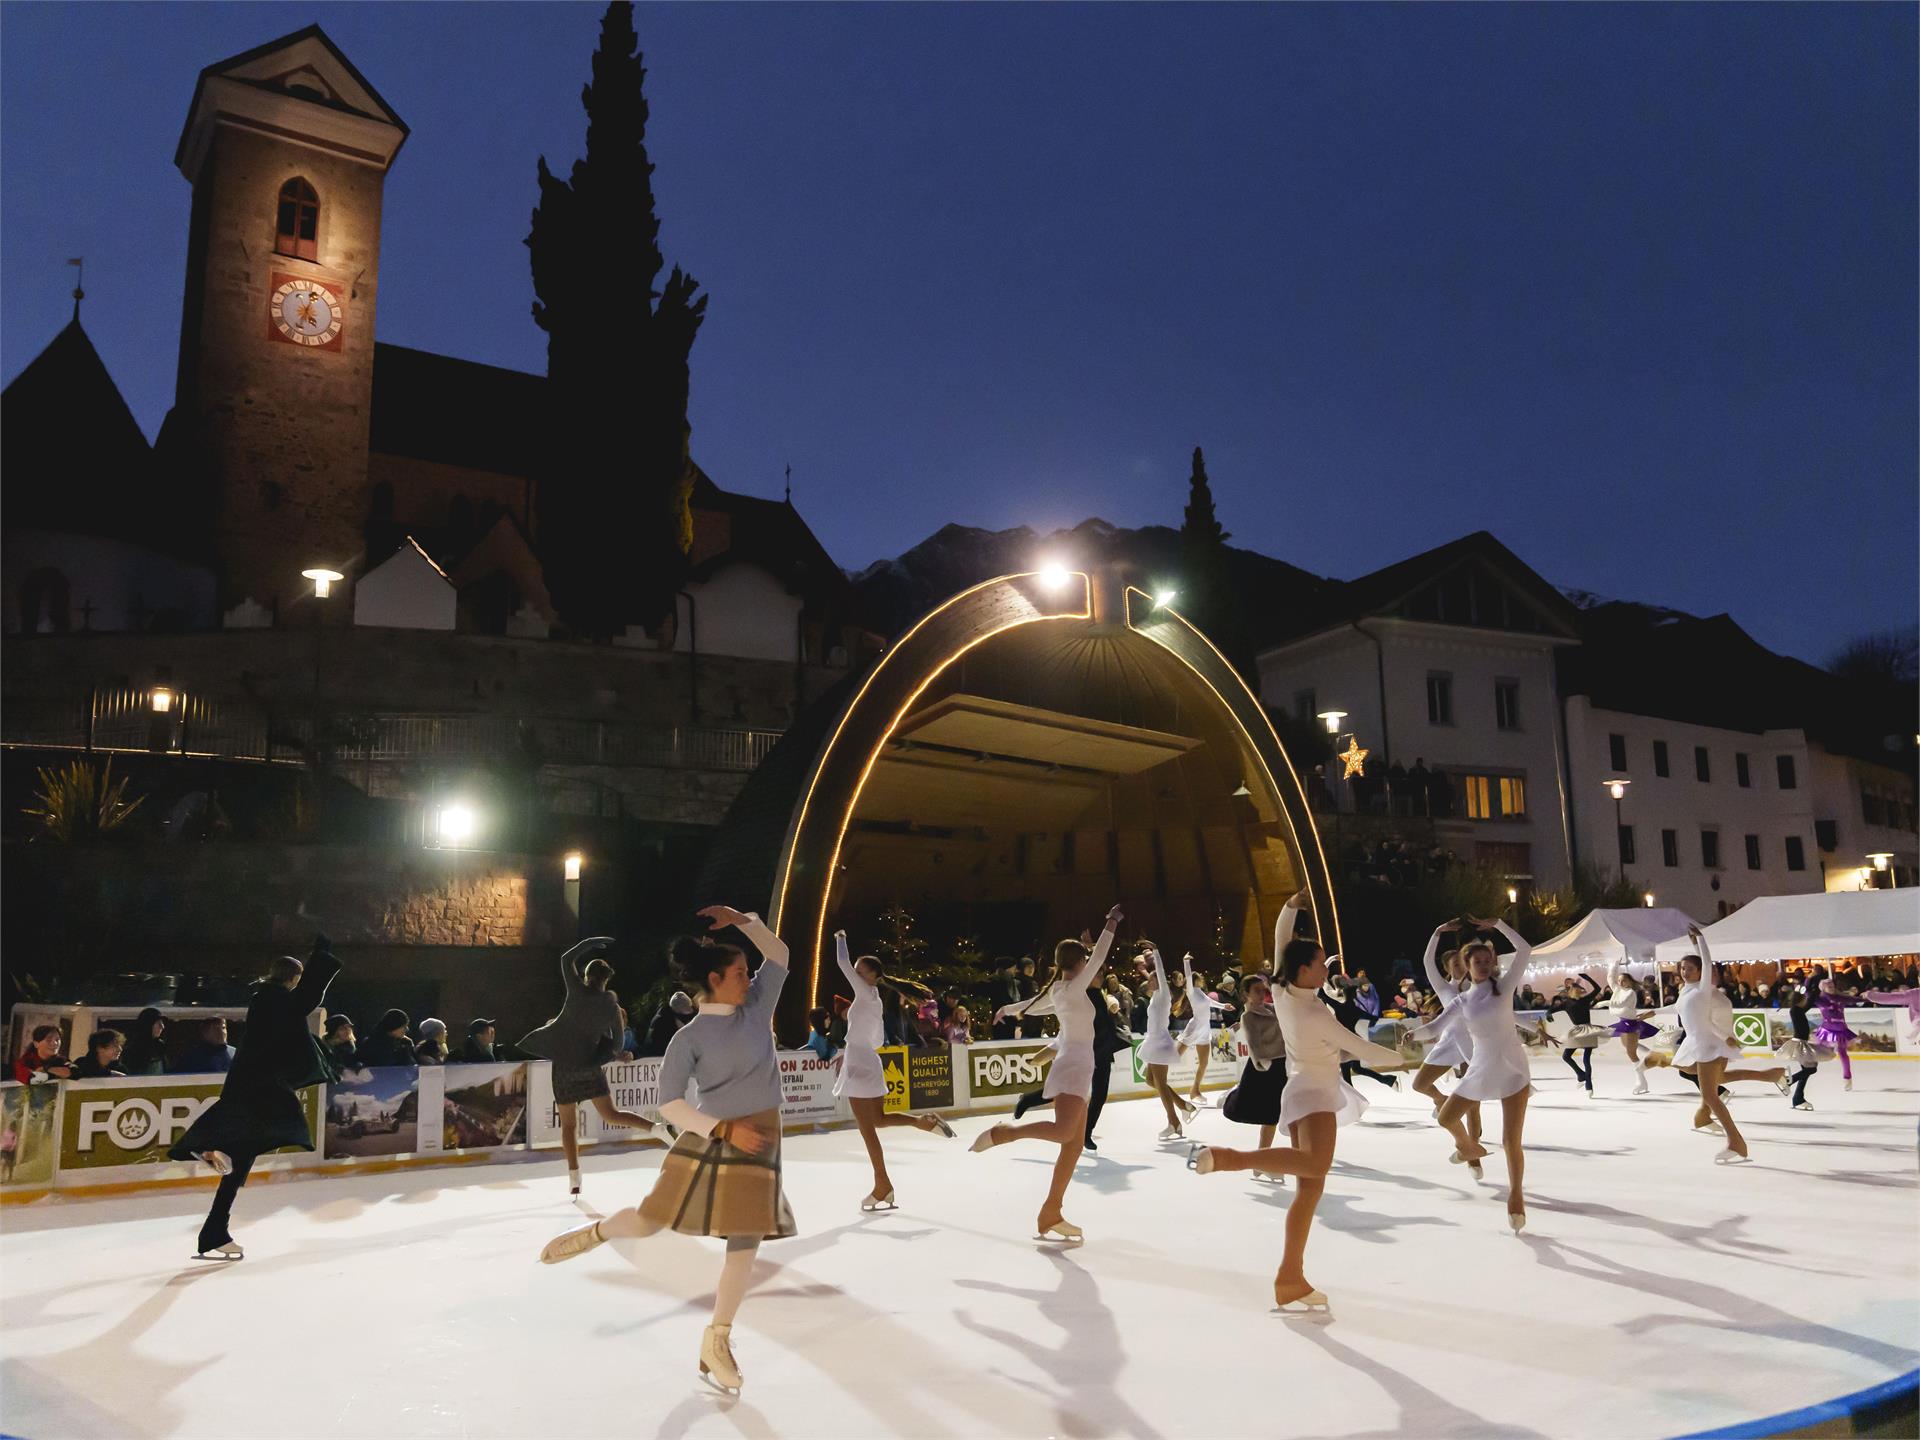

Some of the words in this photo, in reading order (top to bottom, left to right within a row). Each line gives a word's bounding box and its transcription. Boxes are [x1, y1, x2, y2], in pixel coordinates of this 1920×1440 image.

[780, 1060, 797, 1073] ON
[802, 1058, 831, 1072] 2000
[912, 1055, 949, 1066] HIGHEST
[913, 1066, 949, 1078] QUALITY
[974, 1052, 1043, 1087] FORST
[886, 1080, 905, 1095] PS
[78, 1096, 220, 1151] FOR
